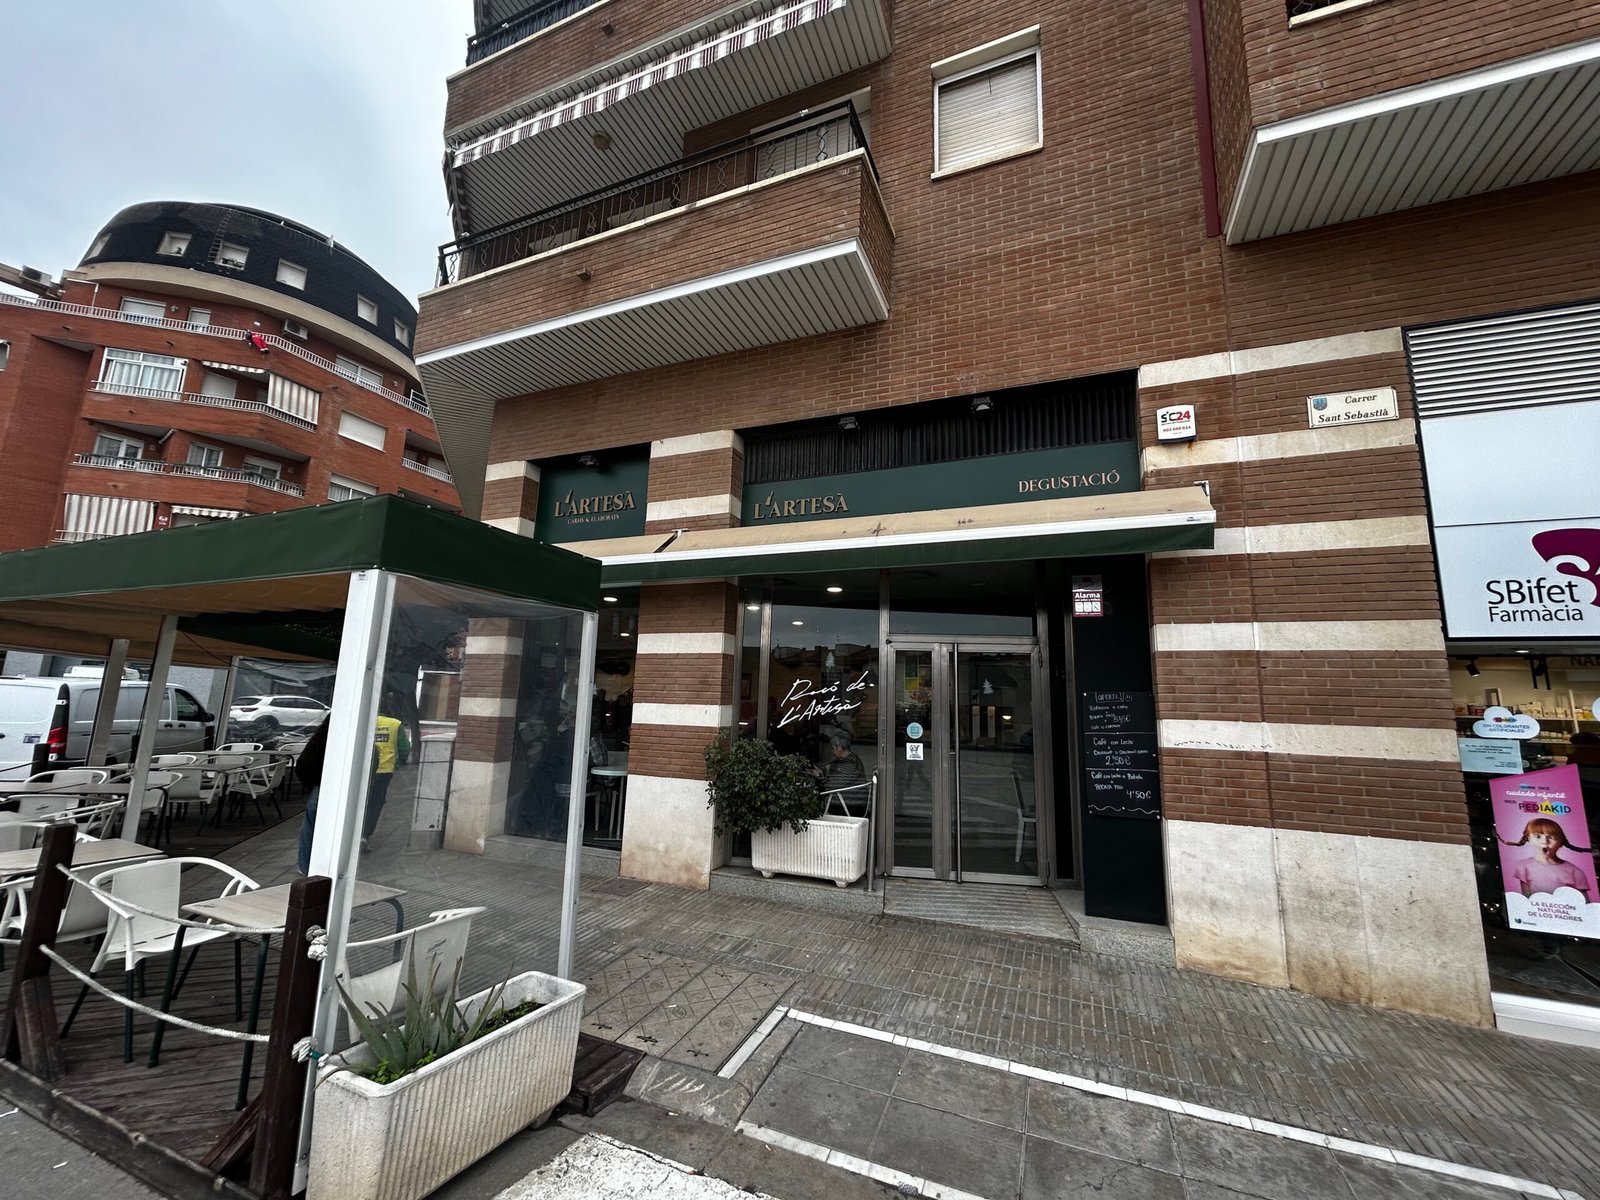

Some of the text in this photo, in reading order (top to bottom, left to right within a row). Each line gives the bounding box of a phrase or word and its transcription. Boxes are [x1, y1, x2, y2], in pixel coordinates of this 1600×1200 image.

[1345, 394, 1377, 404] Carrer
[1319, 408, 1389, 423] Sant Sebastià
[1018, 469, 1120, 493] DEGUSTACIÓ
[554, 489, 635, 518] L'ARTESÀ
[753, 491, 849, 519] L'ARTESÀ
[1486, 577, 1581, 605] SBifet
[1488, 604, 1584, 622] Farmàcia
[845, 670, 869, 692] de
[1518, 802, 1572, 814] PEDIAKID
[1537, 907, 1570, 915] NATURAL
[1541, 903, 1577, 911] ELECCIÓN
[1554, 914, 1583, 922] PADRES
